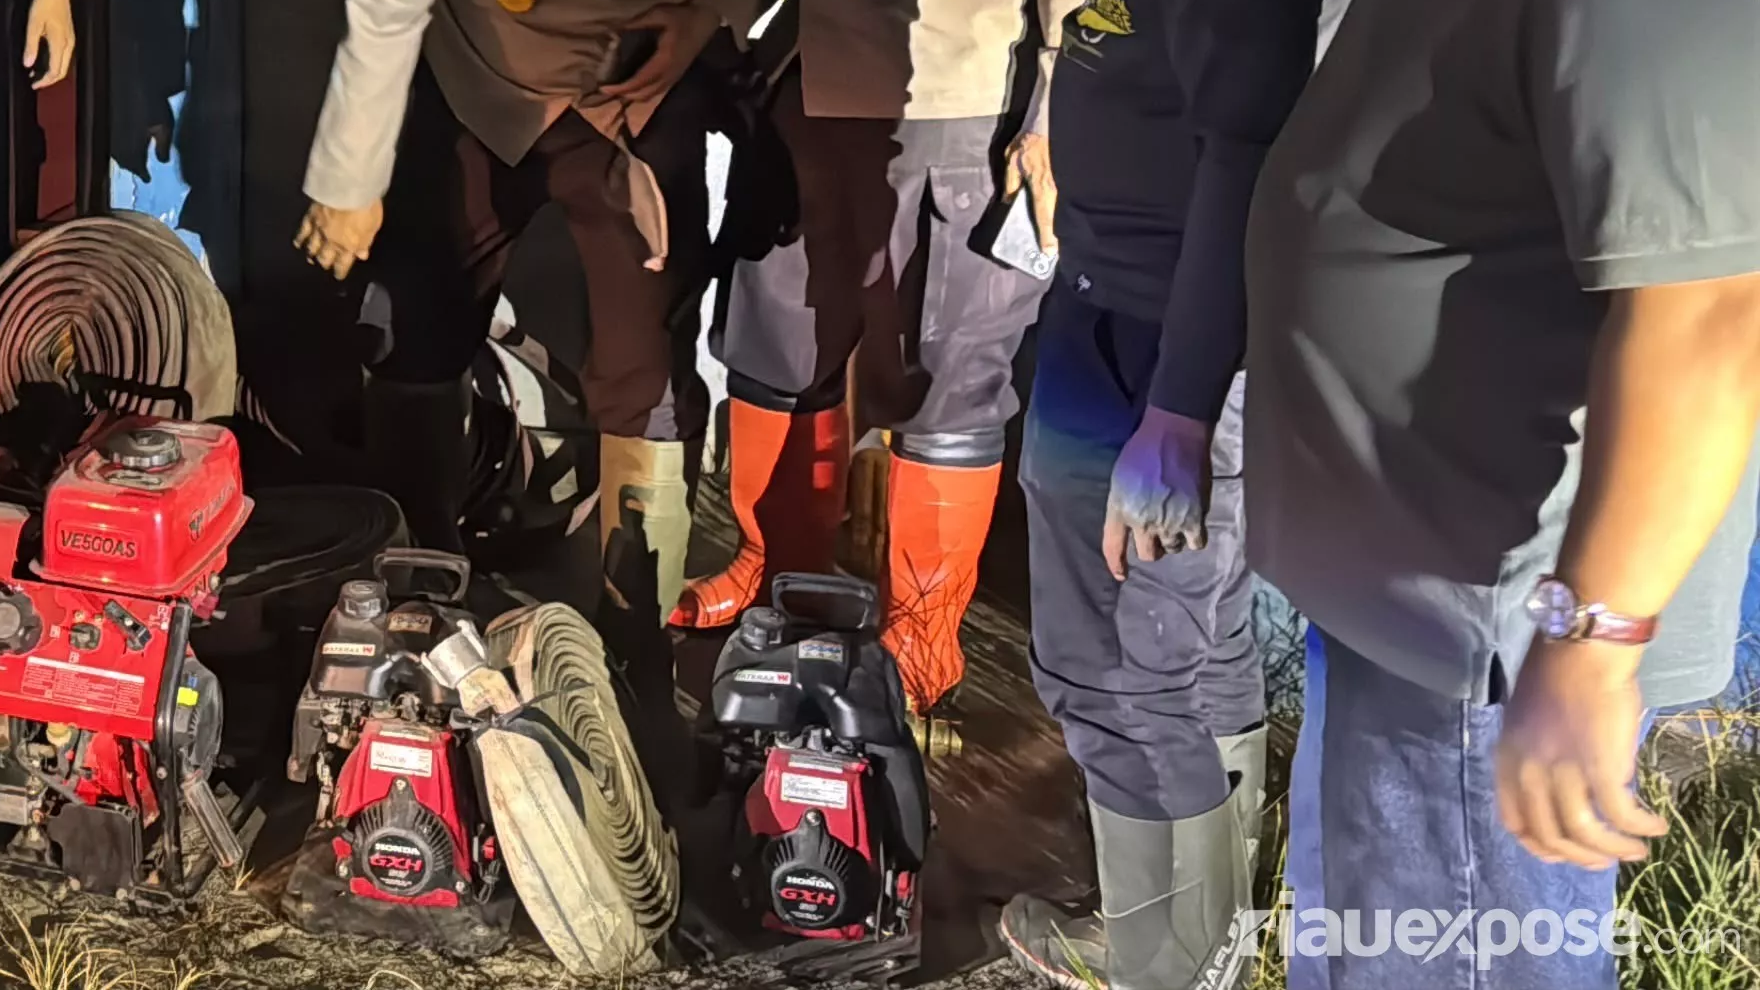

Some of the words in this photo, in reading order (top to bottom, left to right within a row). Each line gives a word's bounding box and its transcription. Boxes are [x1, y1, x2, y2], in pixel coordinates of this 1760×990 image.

[370, 854, 422, 872] GXH
[786, 875, 835, 890] HONDA
[780, 887, 836, 906] GXH
